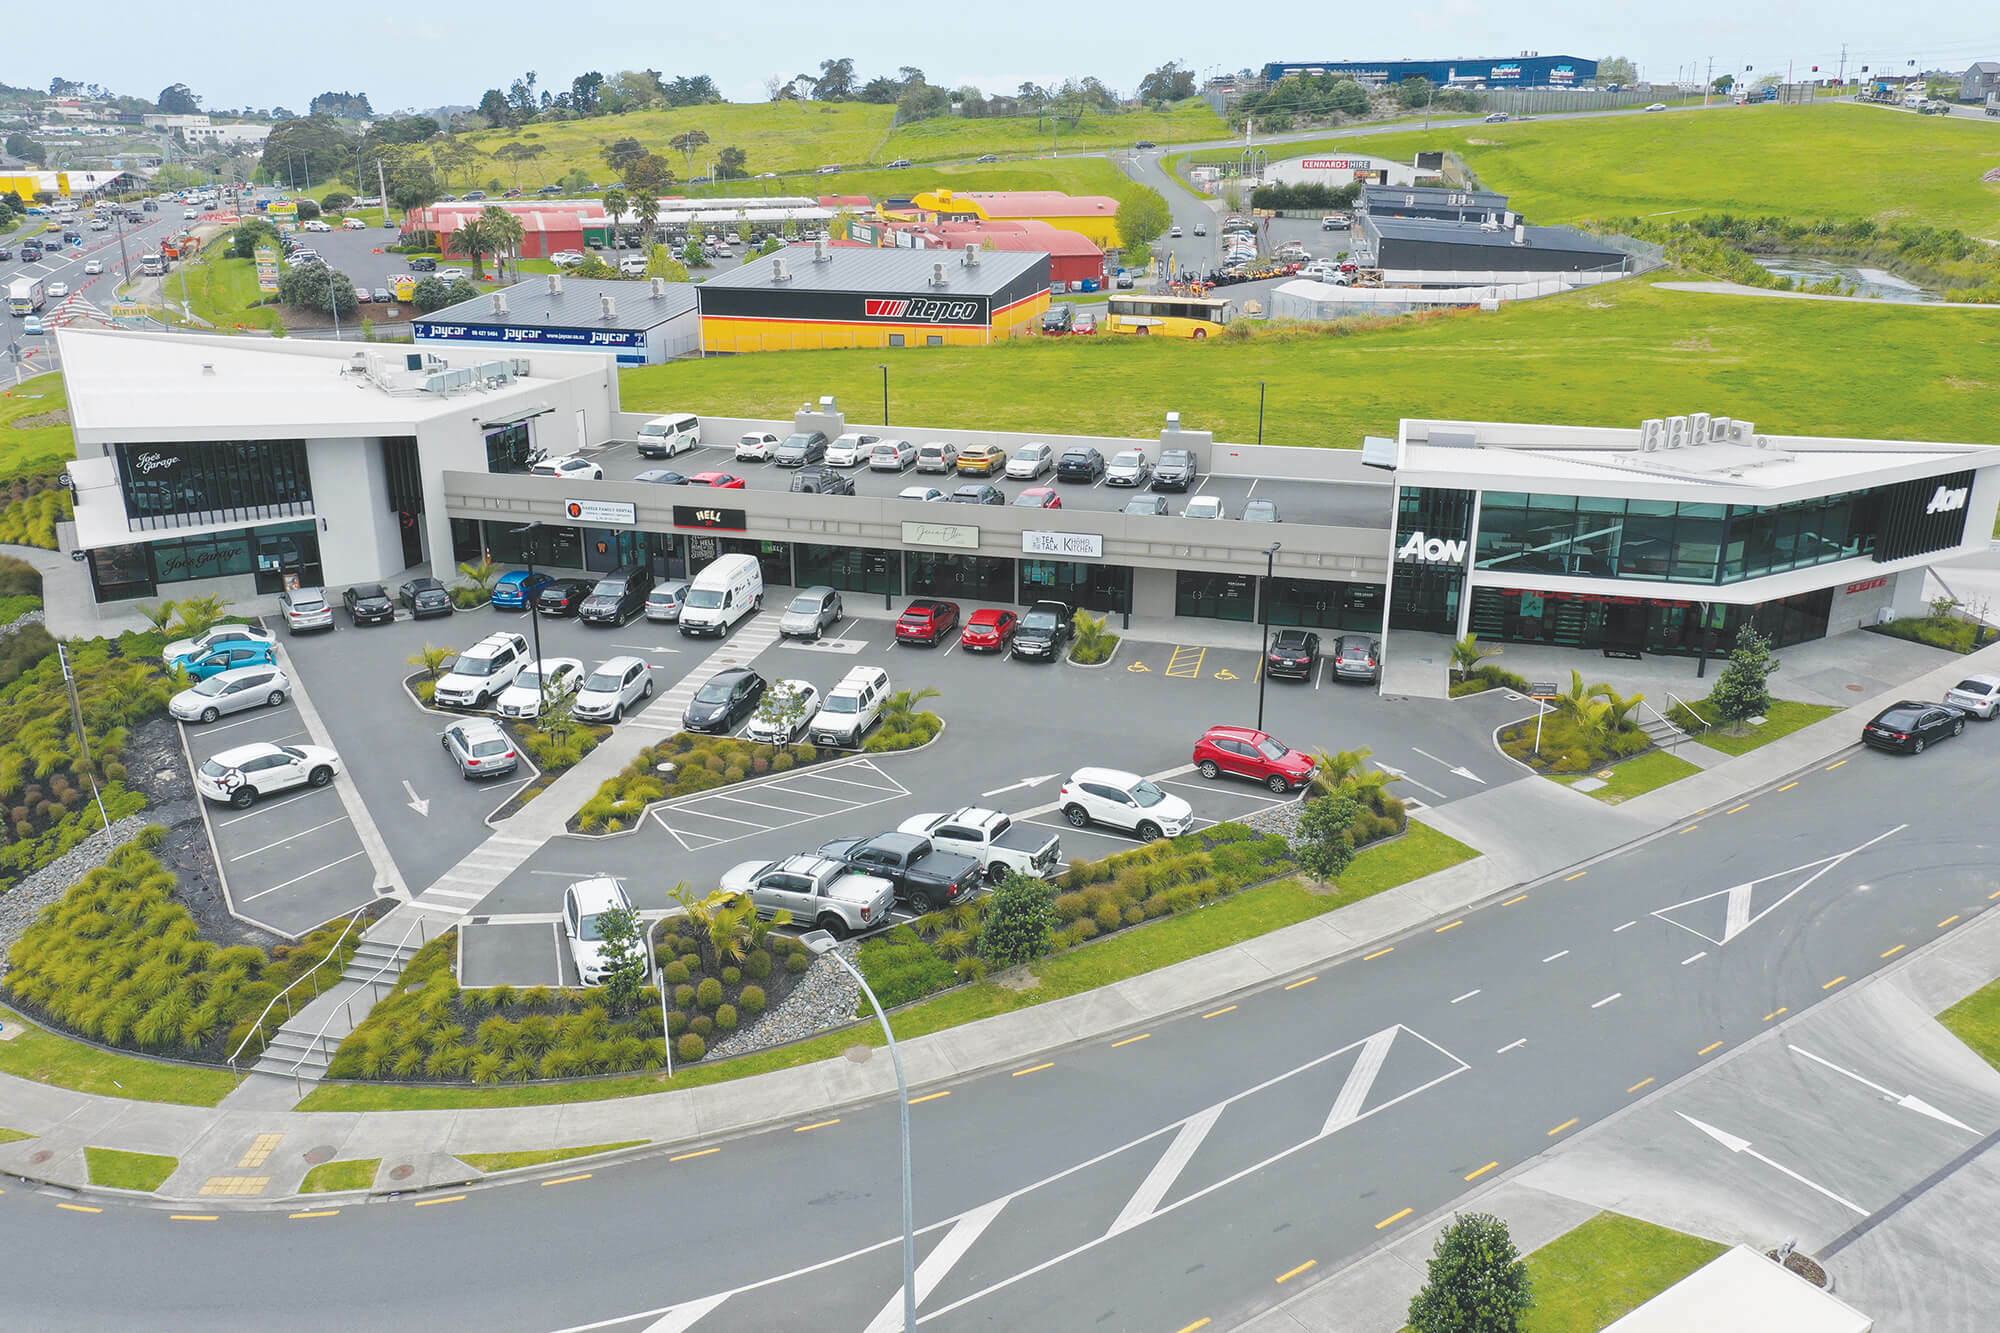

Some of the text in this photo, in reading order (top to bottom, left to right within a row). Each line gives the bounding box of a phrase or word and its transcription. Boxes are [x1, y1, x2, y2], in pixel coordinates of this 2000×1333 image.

[1304, 160, 1369, 169] KENNARDS HIRE
[906, 298, 978, 322] Repco
[136, 452, 161, 469] Joe's
[142, 456, 181, 475] Garage
[695, 509, 721, 523] HELL
[1041, 535, 1054, 545] TEA
[1041, 543, 1059, 552] TALK
[195, 547, 242, 568] Garage
